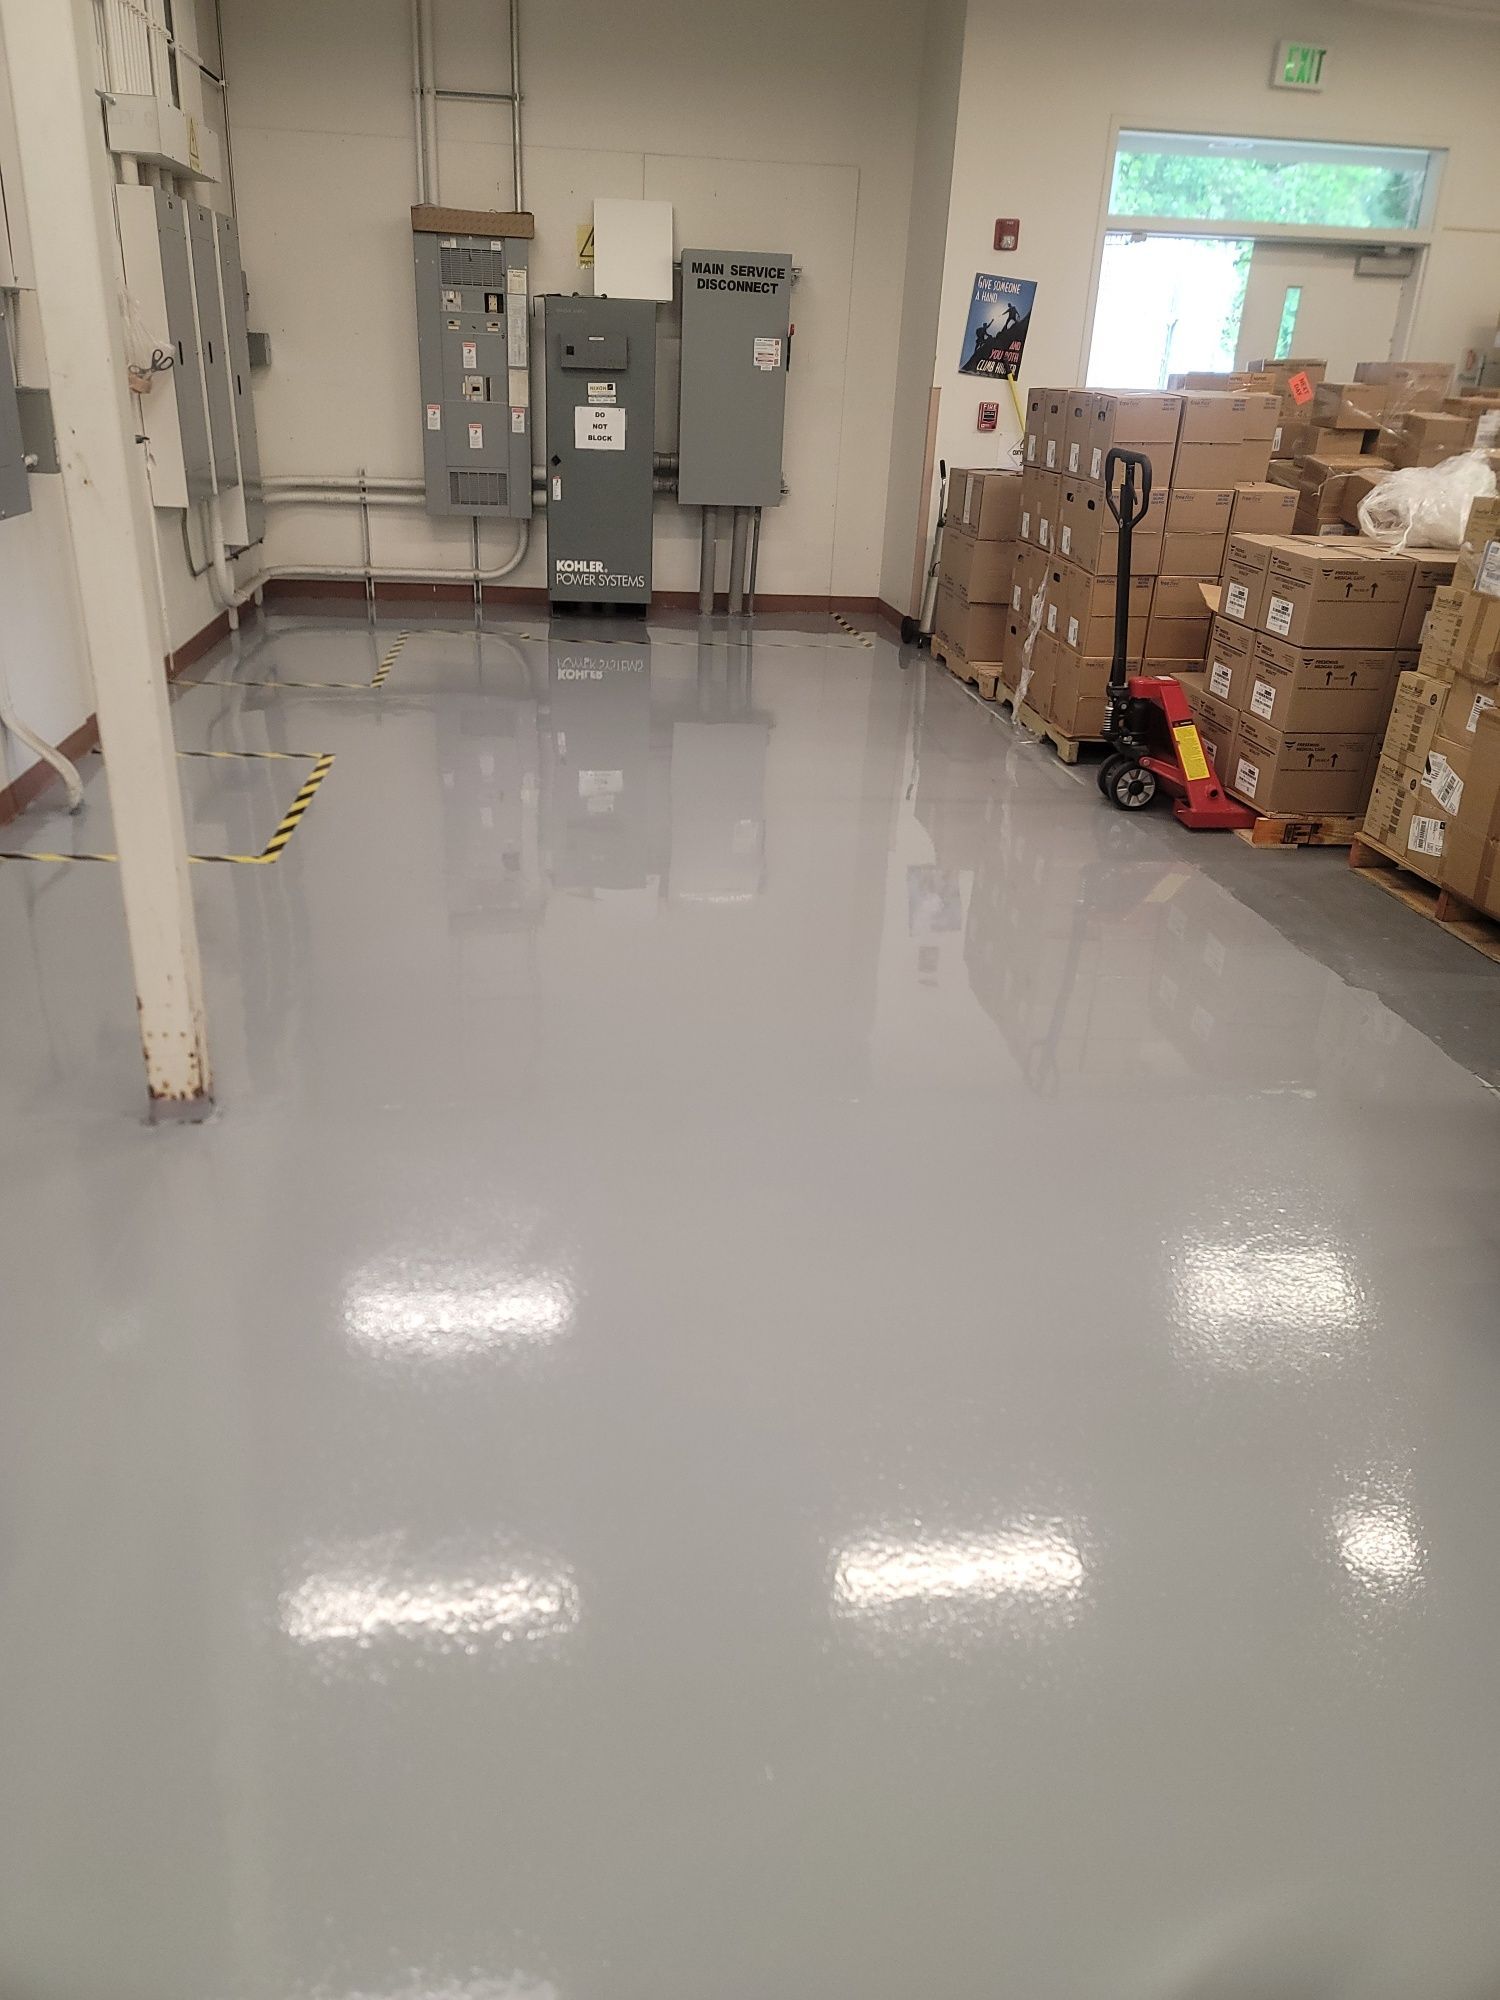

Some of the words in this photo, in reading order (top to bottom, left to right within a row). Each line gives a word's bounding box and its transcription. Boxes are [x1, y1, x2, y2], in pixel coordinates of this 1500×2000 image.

[1284, 46, 1327, 84] EXIT
[691, 262, 724, 275] MAIN
[730, 264, 786, 280] SERVICE
[697, 278, 779, 295] DISCONNECT
[977, 275, 993, 290] GIVE
[992, 280, 1022, 295] SOMEONE
[974, 290, 981, 301] A
[981, 291, 998, 303] HAND
[1008, 340, 1022, 351] AND
[988, 348, 1004, 360] YOU
[976, 359, 996, 372] CLIMB
[587, 434, 613, 442] BLOCK
[556, 560, 604, 573] KOHLER
[556, 573, 596, 586] POWER
[598, 574, 645, 588] SYSTEMS
